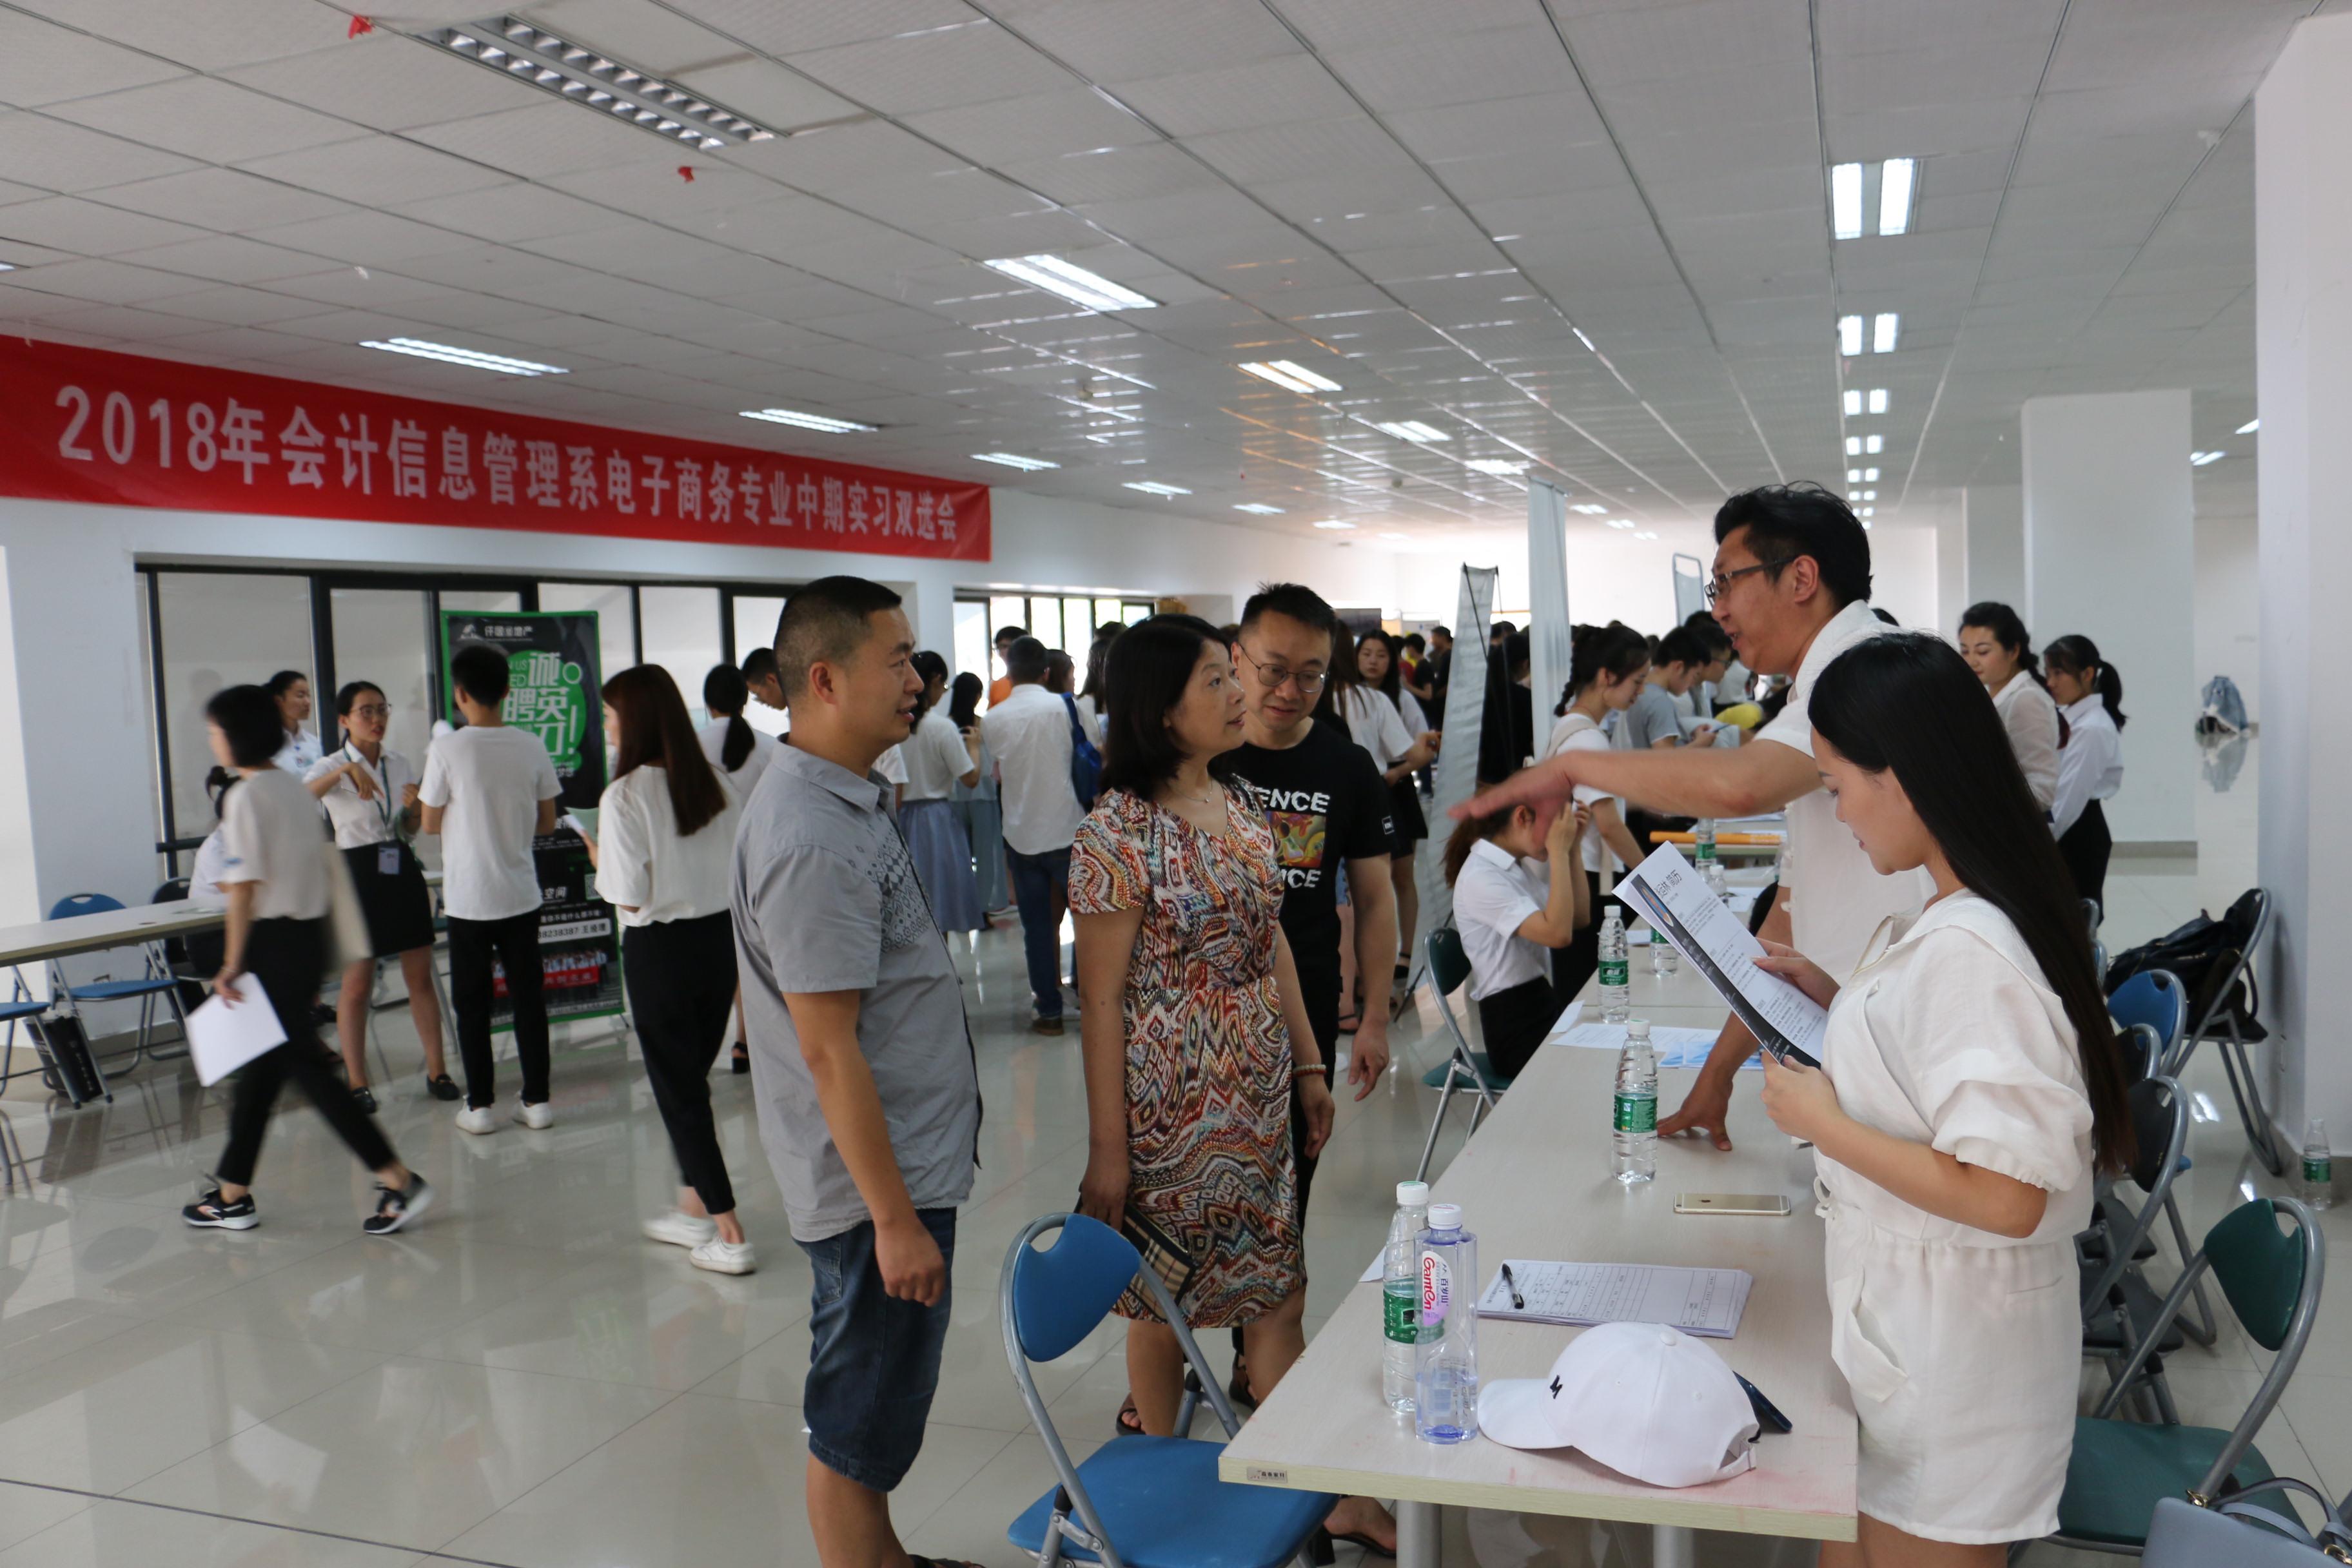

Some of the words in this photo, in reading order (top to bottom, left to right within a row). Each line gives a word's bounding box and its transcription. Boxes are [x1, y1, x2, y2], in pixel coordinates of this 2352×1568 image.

[55, 385, 957, 542] 2018年会计信息管理系电子商务专业中期实习双选会
